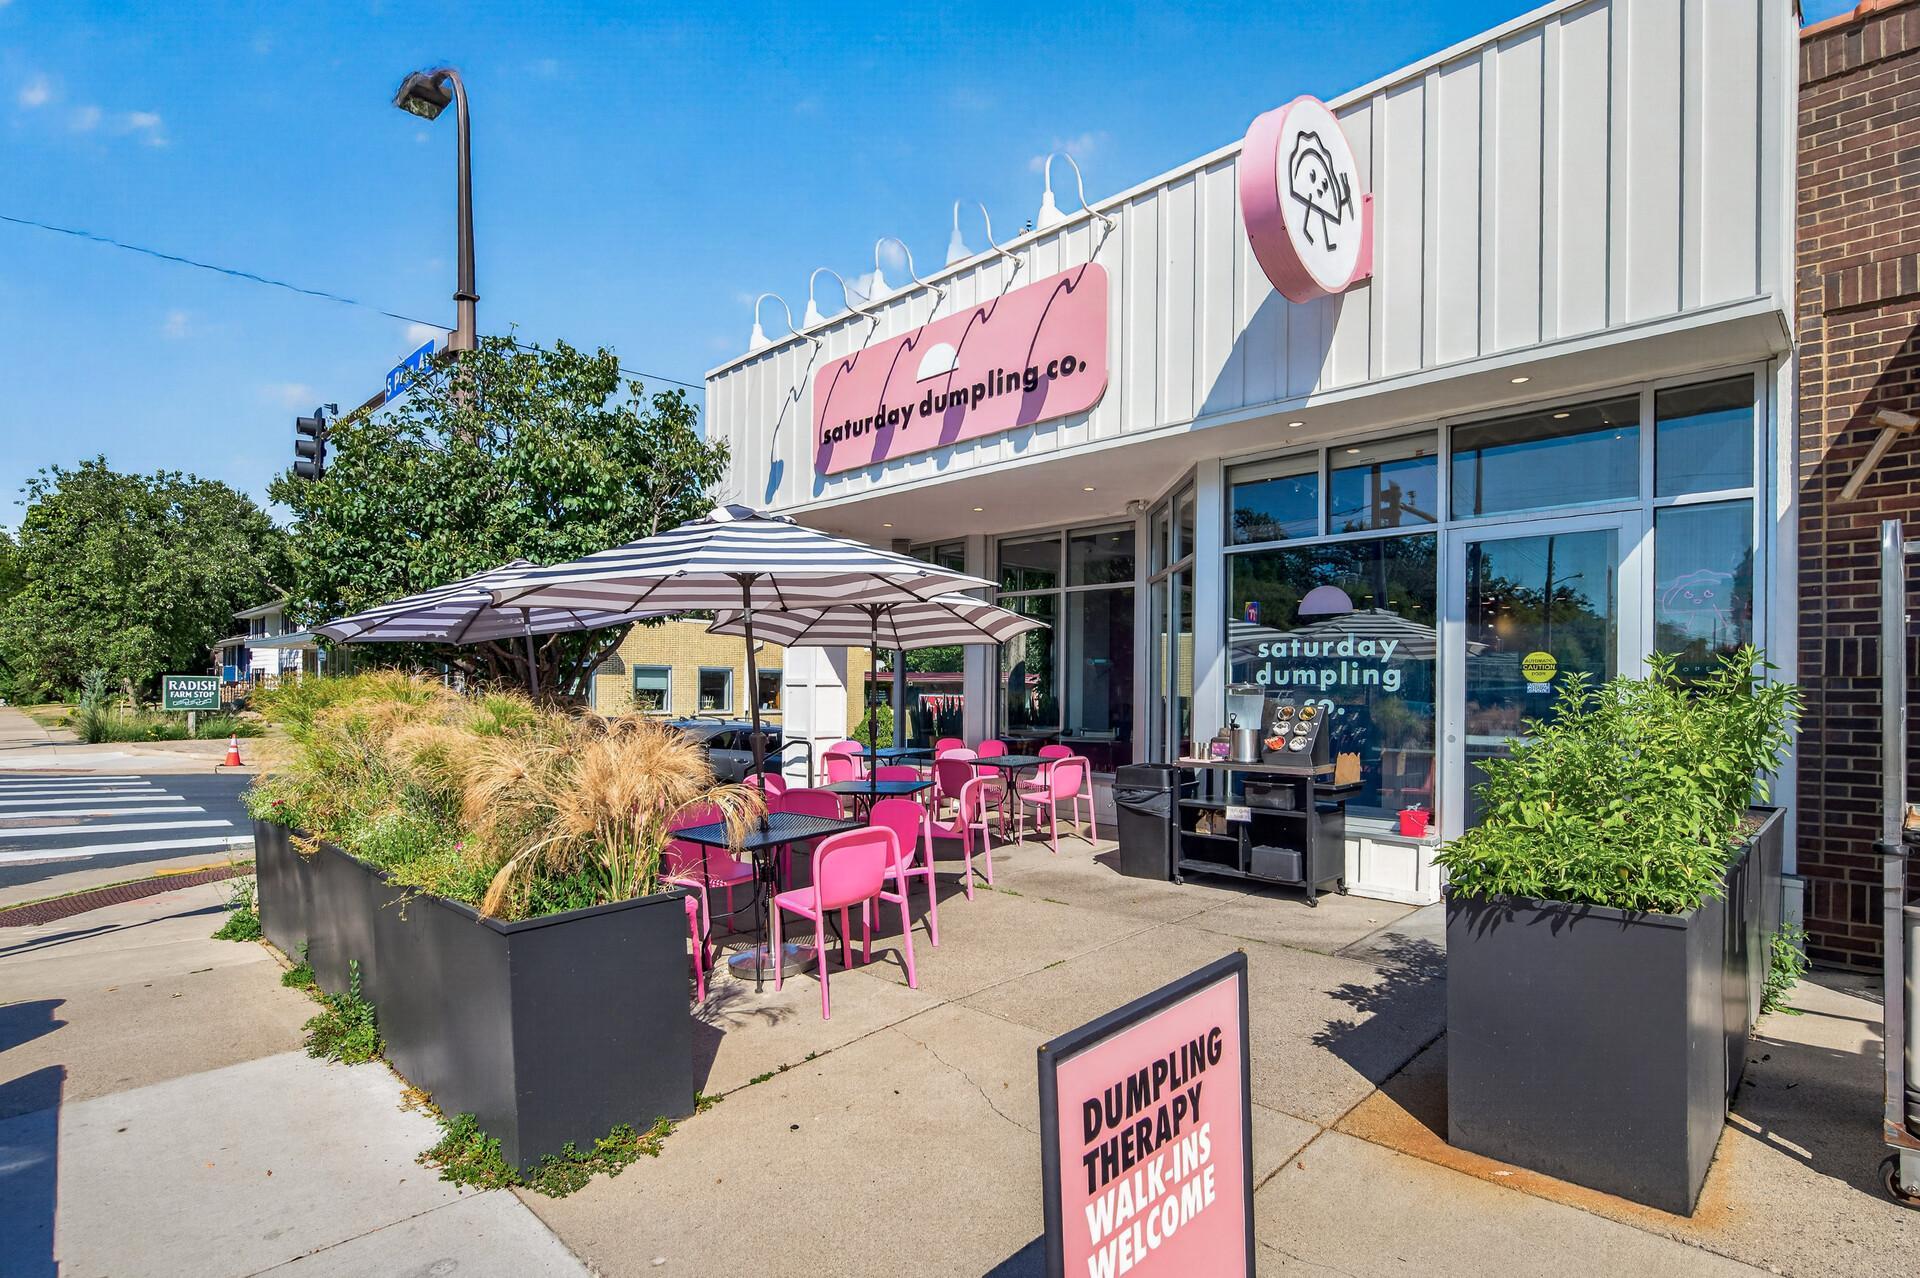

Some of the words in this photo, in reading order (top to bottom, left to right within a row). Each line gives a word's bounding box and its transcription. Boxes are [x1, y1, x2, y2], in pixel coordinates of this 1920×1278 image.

[387, 377, 391, 397] S
[823, 404, 914, 444] saturday
[919, 366, 1039, 418] dumpling
[1046, 355, 1087, 380] co.
[169, 680, 217, 690] RADISH
[1256, 661, 1401, 692] dumpling
[1258, 633, 1399, 662] saturday
[1083, 1026, 1223, 1145] DUMPLING
[1083, 1081, 1203, 1196] THERAPY
[1085, 1122, 1211, 1246] WALK-INS
[1087, 1164, 1216, 1278] WELCOME
